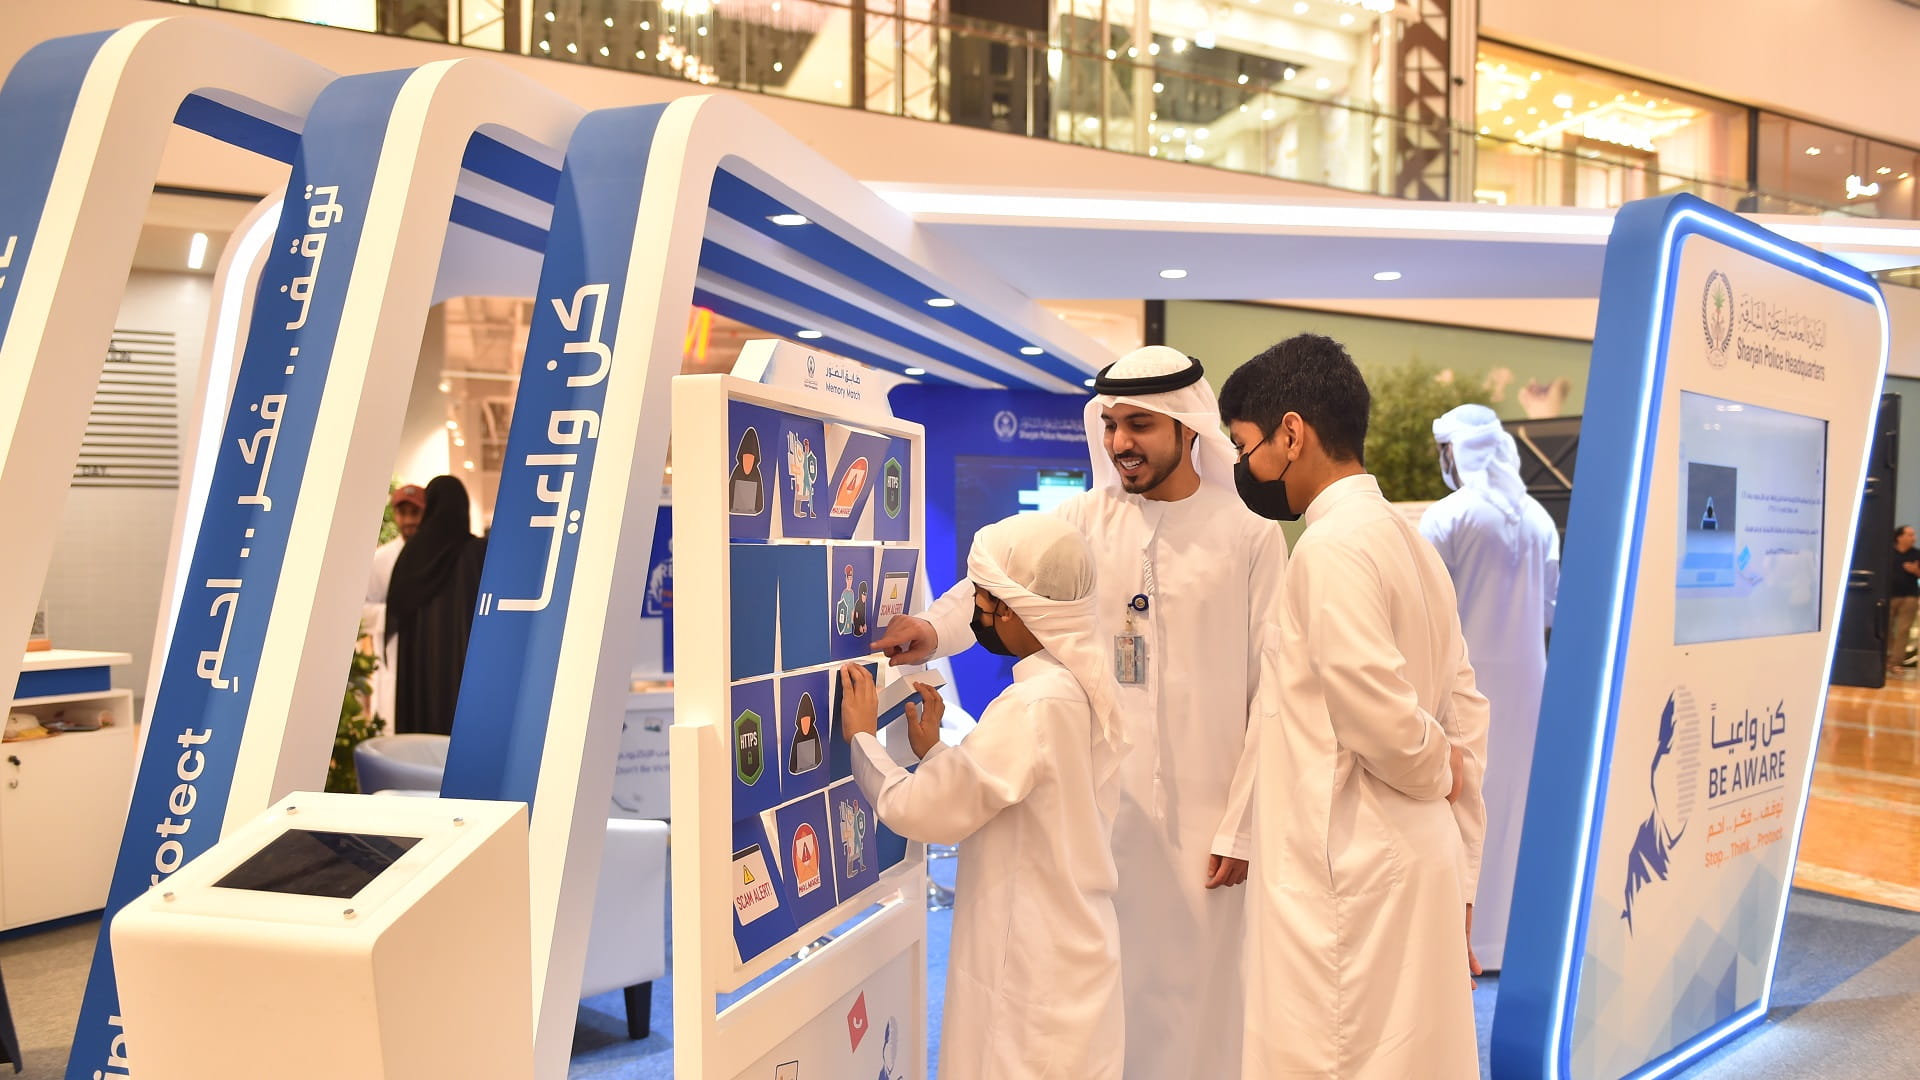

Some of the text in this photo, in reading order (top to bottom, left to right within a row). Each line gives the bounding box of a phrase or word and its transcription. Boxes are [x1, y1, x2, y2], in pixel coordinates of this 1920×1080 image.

[281, 184, 343, 330] توقف
[546, 283, 612, 387] كن
[1737, 336, 1825, 382] Sharjah Police Headquarters
[825, 381, 845, 399] Memory
[846, 388, 861, 401] Match
[237, 394, 288, 512] فكر
[739, 731, 758, 750] HTTPS
[1762, 699, 1786, 747] كن
[1708, 750, 1786, 799] BE AWARE
[735, 881, 773, 911] SCAM ALERT!
